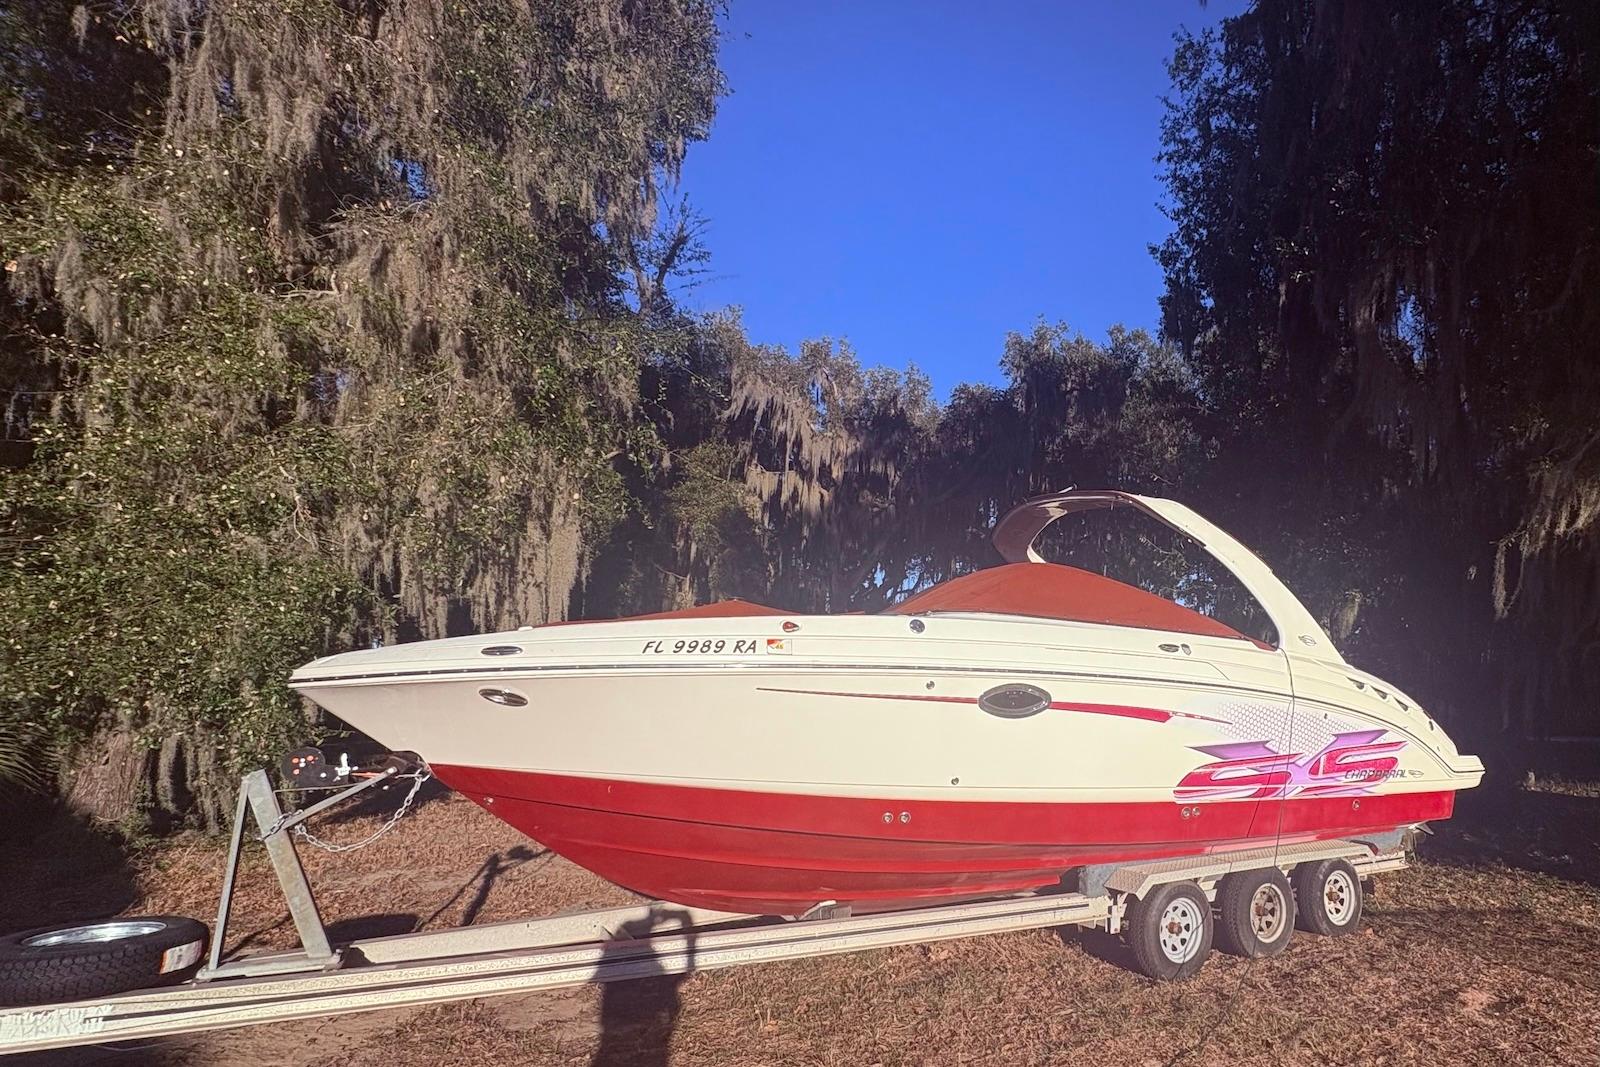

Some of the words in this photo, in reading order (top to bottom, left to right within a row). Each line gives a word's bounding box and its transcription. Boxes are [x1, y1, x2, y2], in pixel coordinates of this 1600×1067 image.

[642, 641, 664, 654] FL
[672, 640, 726, 654] 9989
[733, 640, 757, 654] RA
[1345, 769, 1407, 779] CHAPARRAL
